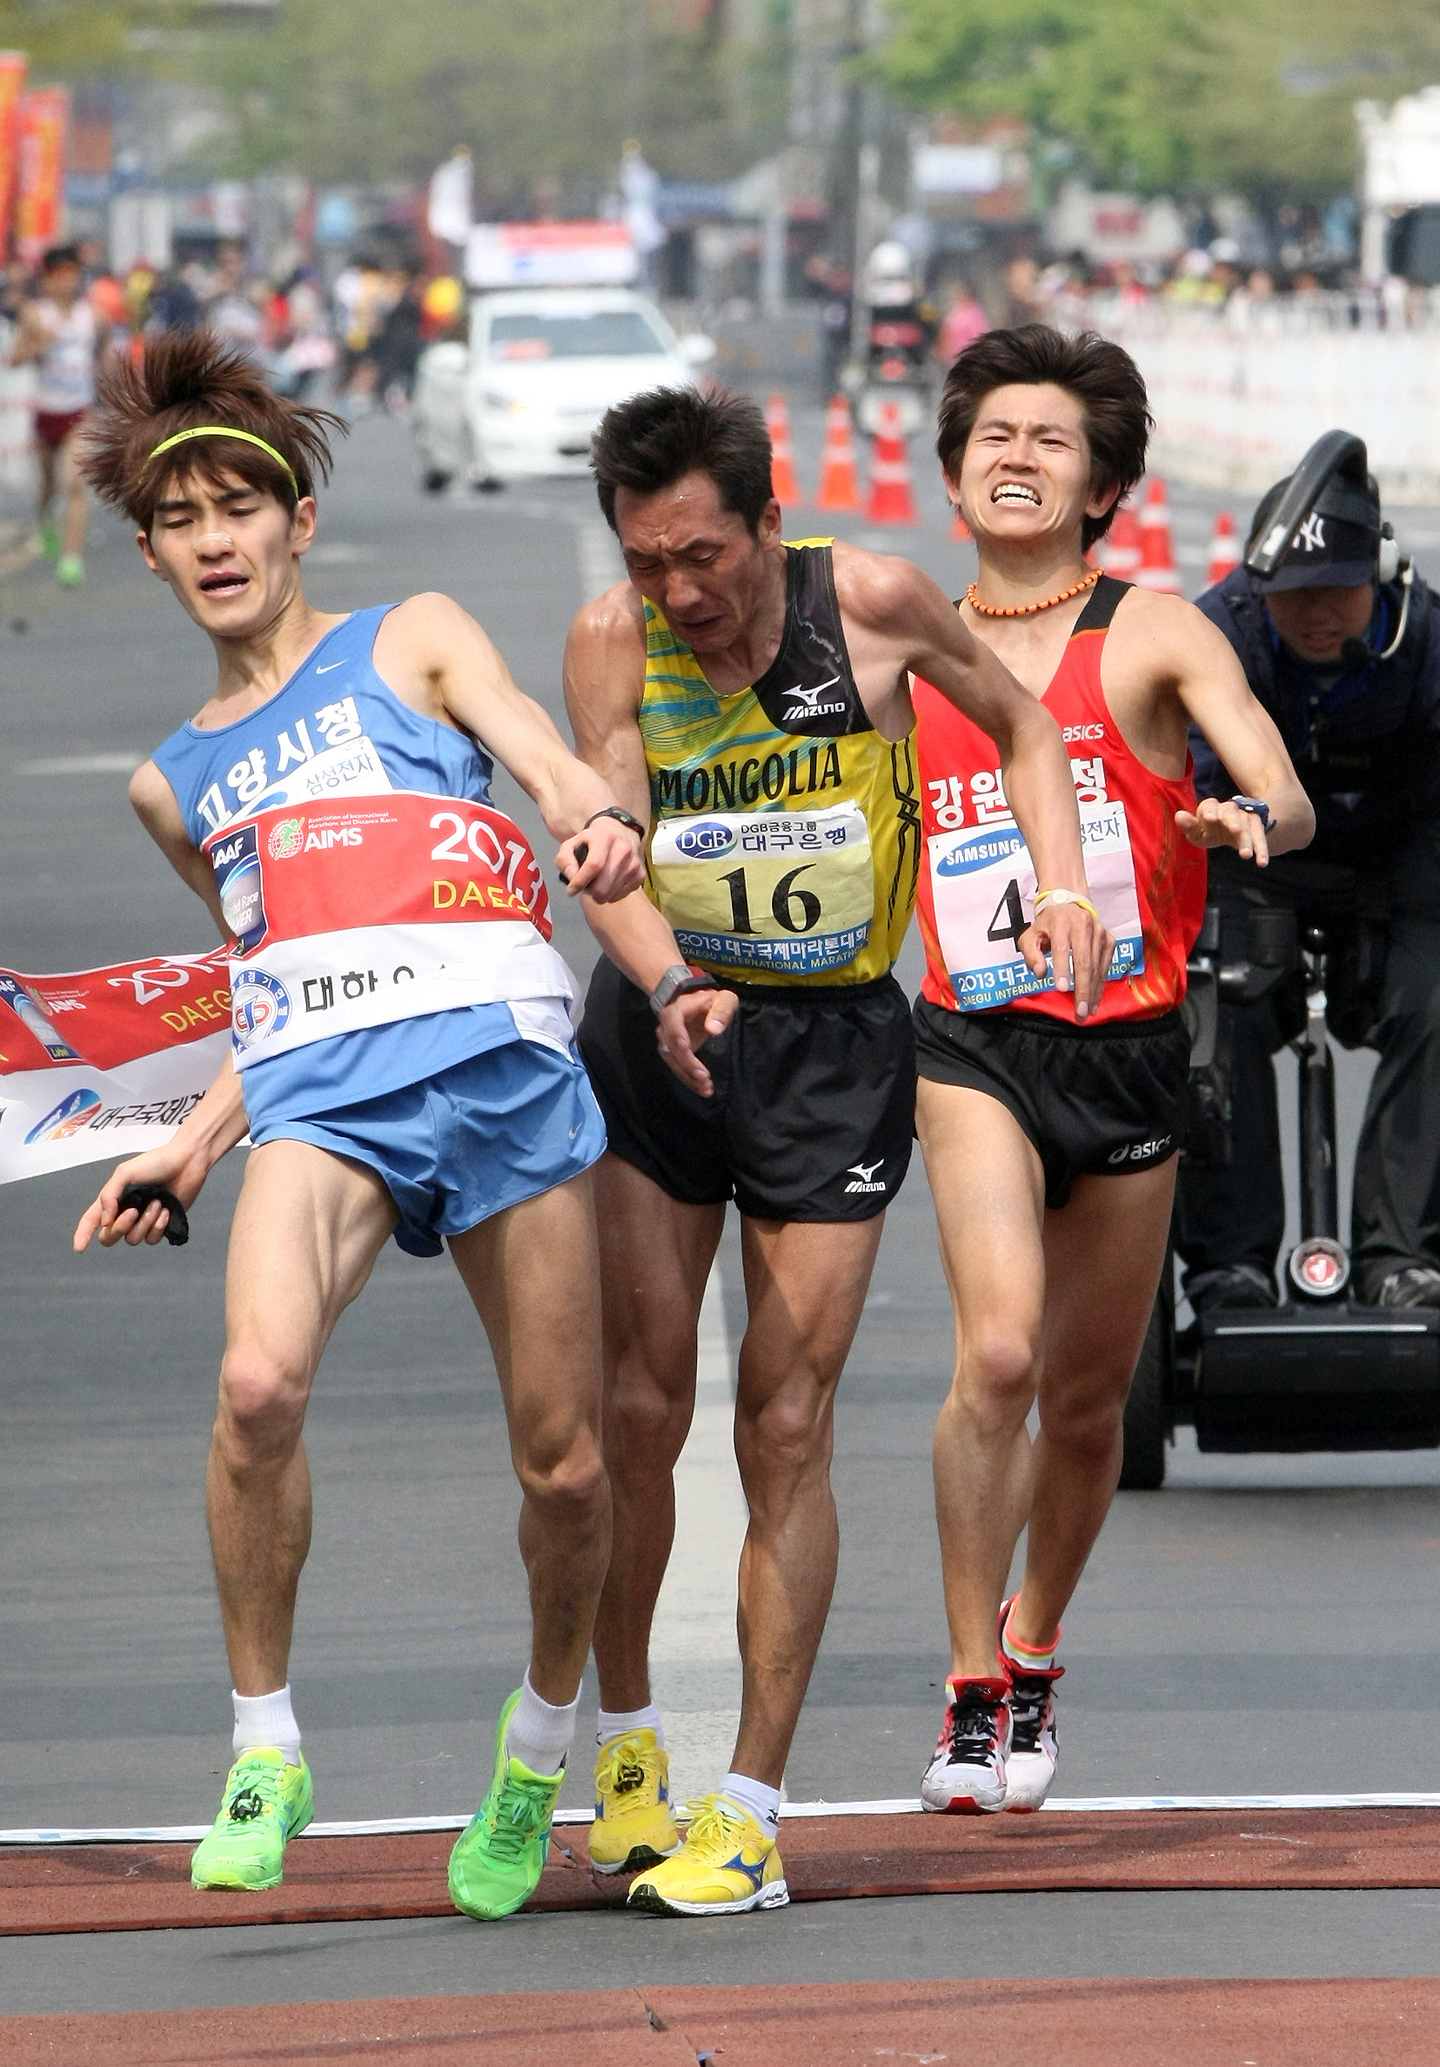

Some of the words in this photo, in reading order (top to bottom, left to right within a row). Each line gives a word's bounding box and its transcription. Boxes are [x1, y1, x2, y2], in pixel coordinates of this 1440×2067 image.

[1062, 723, 1105, 742] asics
[197, 696, 362, 830] 고양시청
[306, 753, 373, 795] 삼성전자
[659, 743, 842, 811] MONGOLIA
[303, 827, 363, 852] AIMS
[681, 831, 728, 849] DGB
[741, 821, 817, 834] DGB금융그룹
[742, 826, 846, 852] 대구은행
[946, 838, 1021, 867] SAMSUNG
[716, 863, 821, 935] 16
[678, 933, 721, 951] 2013
[725, 926, 867, 961] 대구국제마라톤대회
[722, 954, 806, 970] INTERNATIONAL
[958, 973, 996, 993] 2013
[1129, 1134, 1172, 1160] asics
